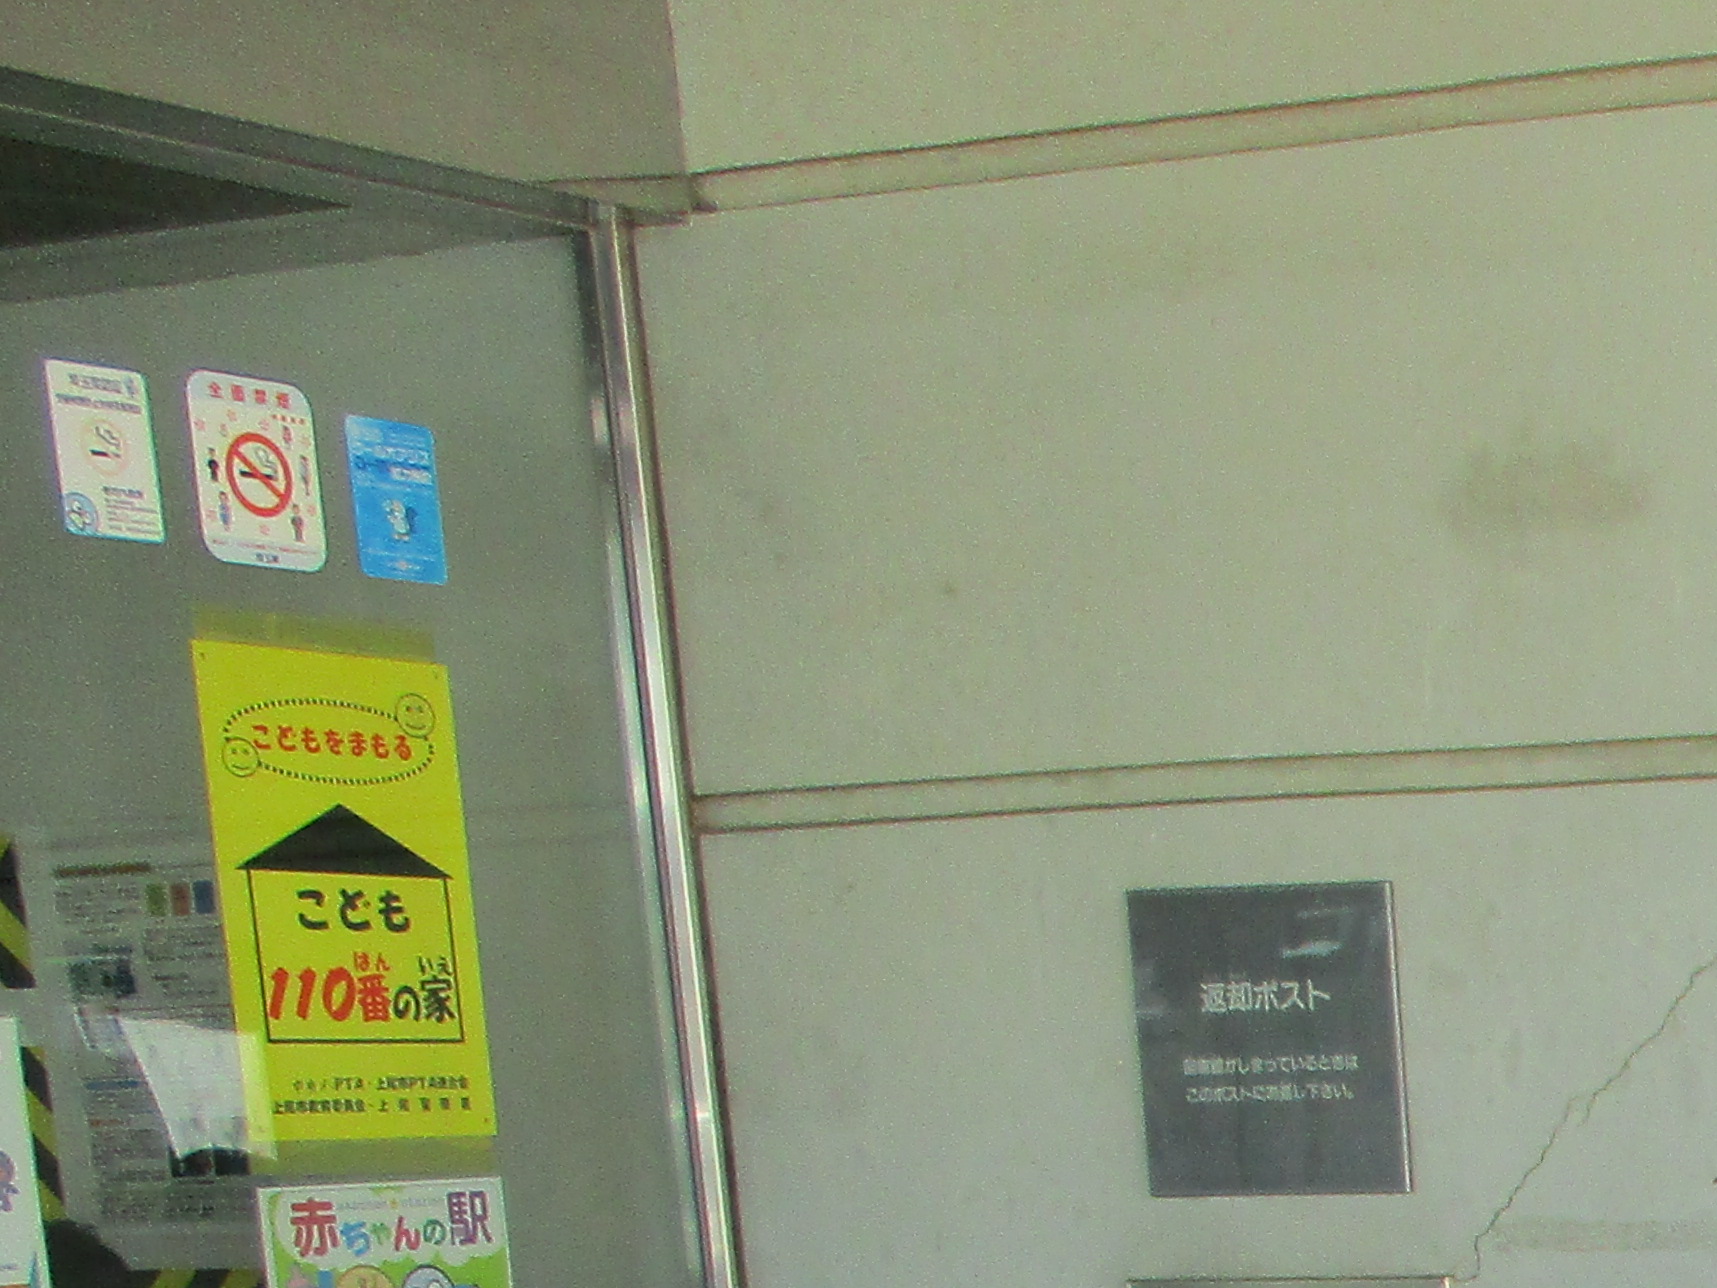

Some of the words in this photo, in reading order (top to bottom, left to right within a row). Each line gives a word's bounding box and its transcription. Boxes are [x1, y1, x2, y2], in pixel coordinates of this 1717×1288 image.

[252, 723, 413, 762] こどもをまもる
[296, 888, 411, 934] こども
[418, 955, 455, 977] いえ
[268, 965, 456, 1025] 110番の家
[1200, 978, 1332, 1014] 返却ポスト
[289, 1189, 495, 1258] 赤ちゃんの駅
